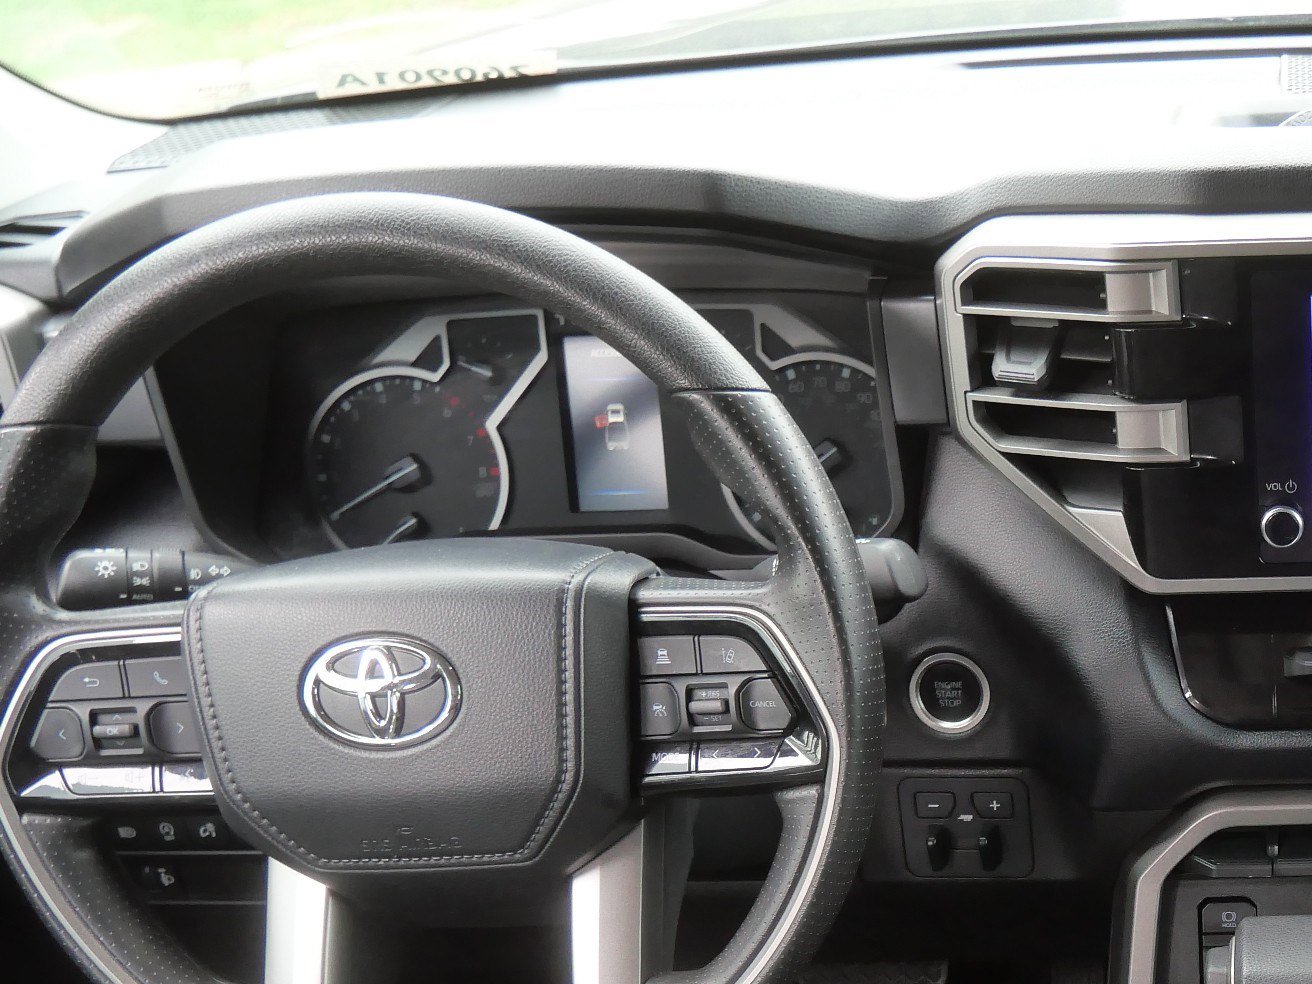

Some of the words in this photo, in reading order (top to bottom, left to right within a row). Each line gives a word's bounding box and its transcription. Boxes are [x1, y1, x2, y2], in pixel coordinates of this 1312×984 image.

[1265, 482, 1282, 491] VOL
[934, 681, 963, 689] ENGINE
[935, 690, 963, 699] START
[749, 700, 777, 709] CANCEL
[939, 700, 962, 708] STOP
[106, 726, 119, 737] OK
